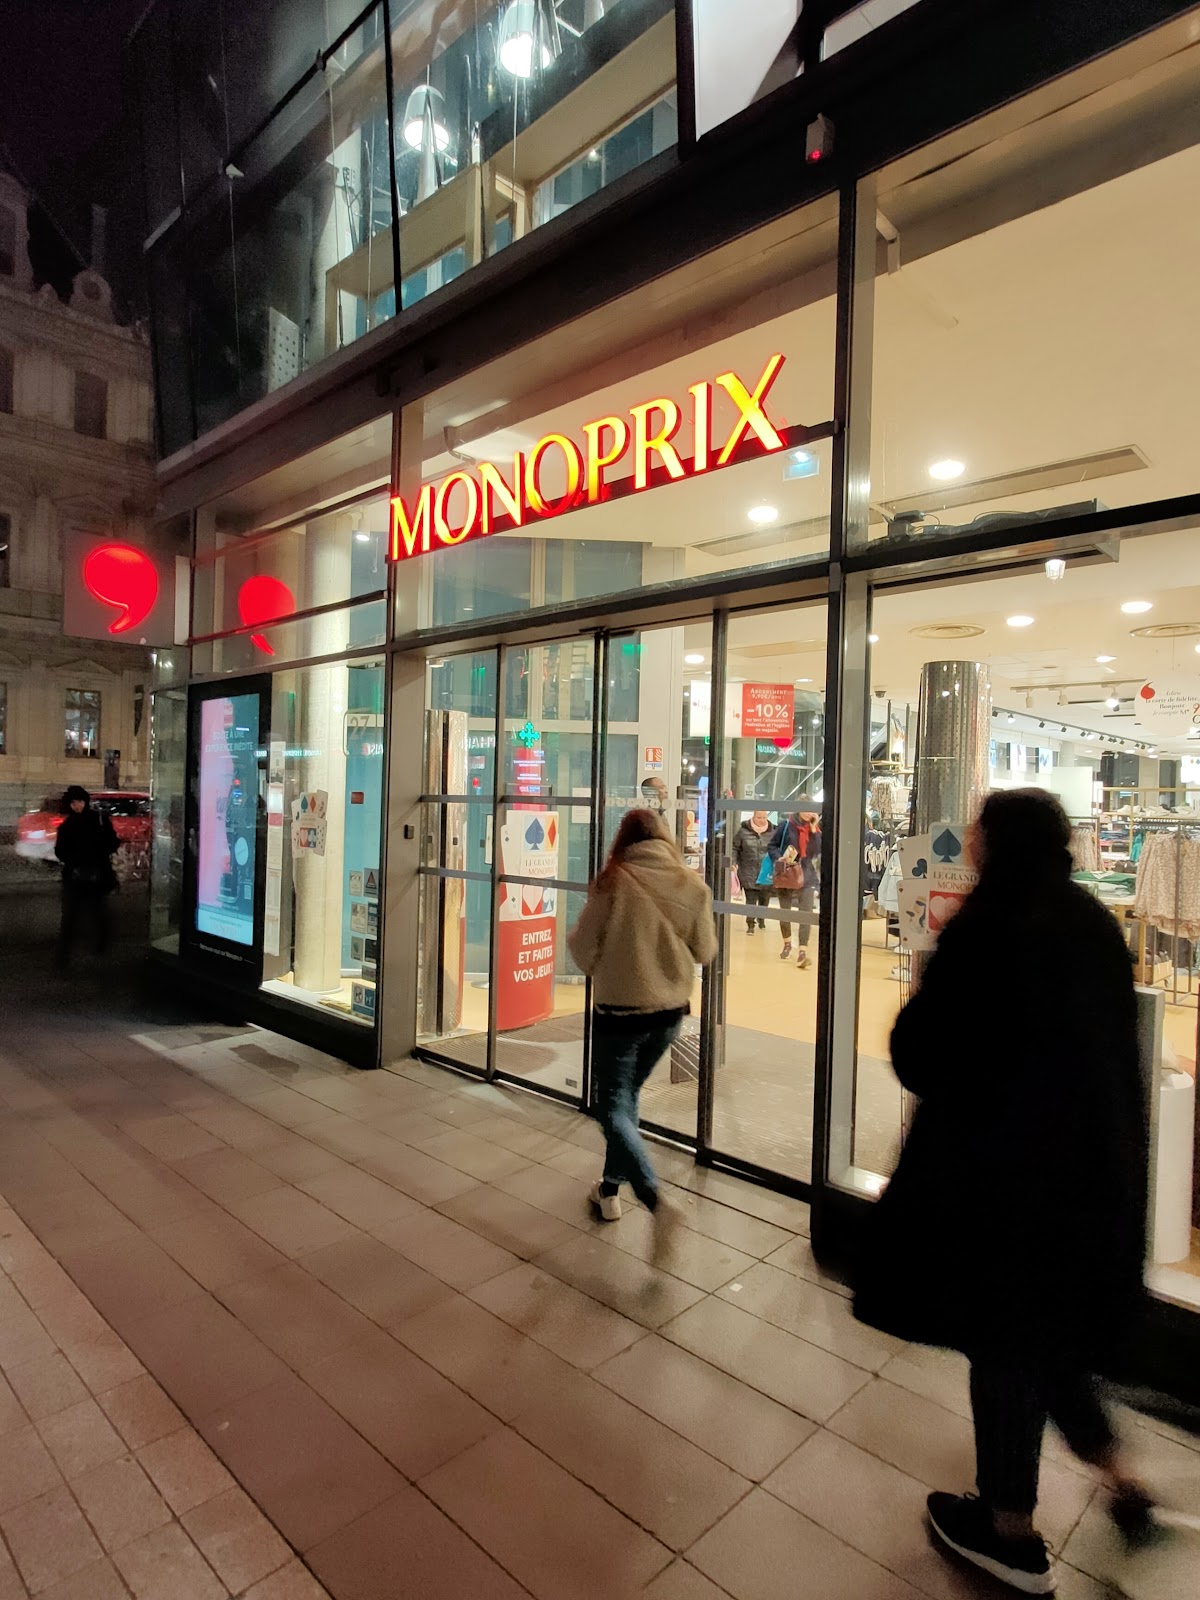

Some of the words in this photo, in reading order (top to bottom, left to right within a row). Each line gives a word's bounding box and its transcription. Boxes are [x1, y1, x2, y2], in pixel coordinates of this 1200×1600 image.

[389, 353, 787, 562] MONOPRIX
[746, 703, 789, 719] -10%
[350, 715, 370, 741] 27
[933, 871, 943, 879] LE
[945, 872, 977, 882] GRAND
[518, 951, 532, 964] ET
[532, 945, 553, 962] FAITES
[513, 968, 534, 983] VOS
